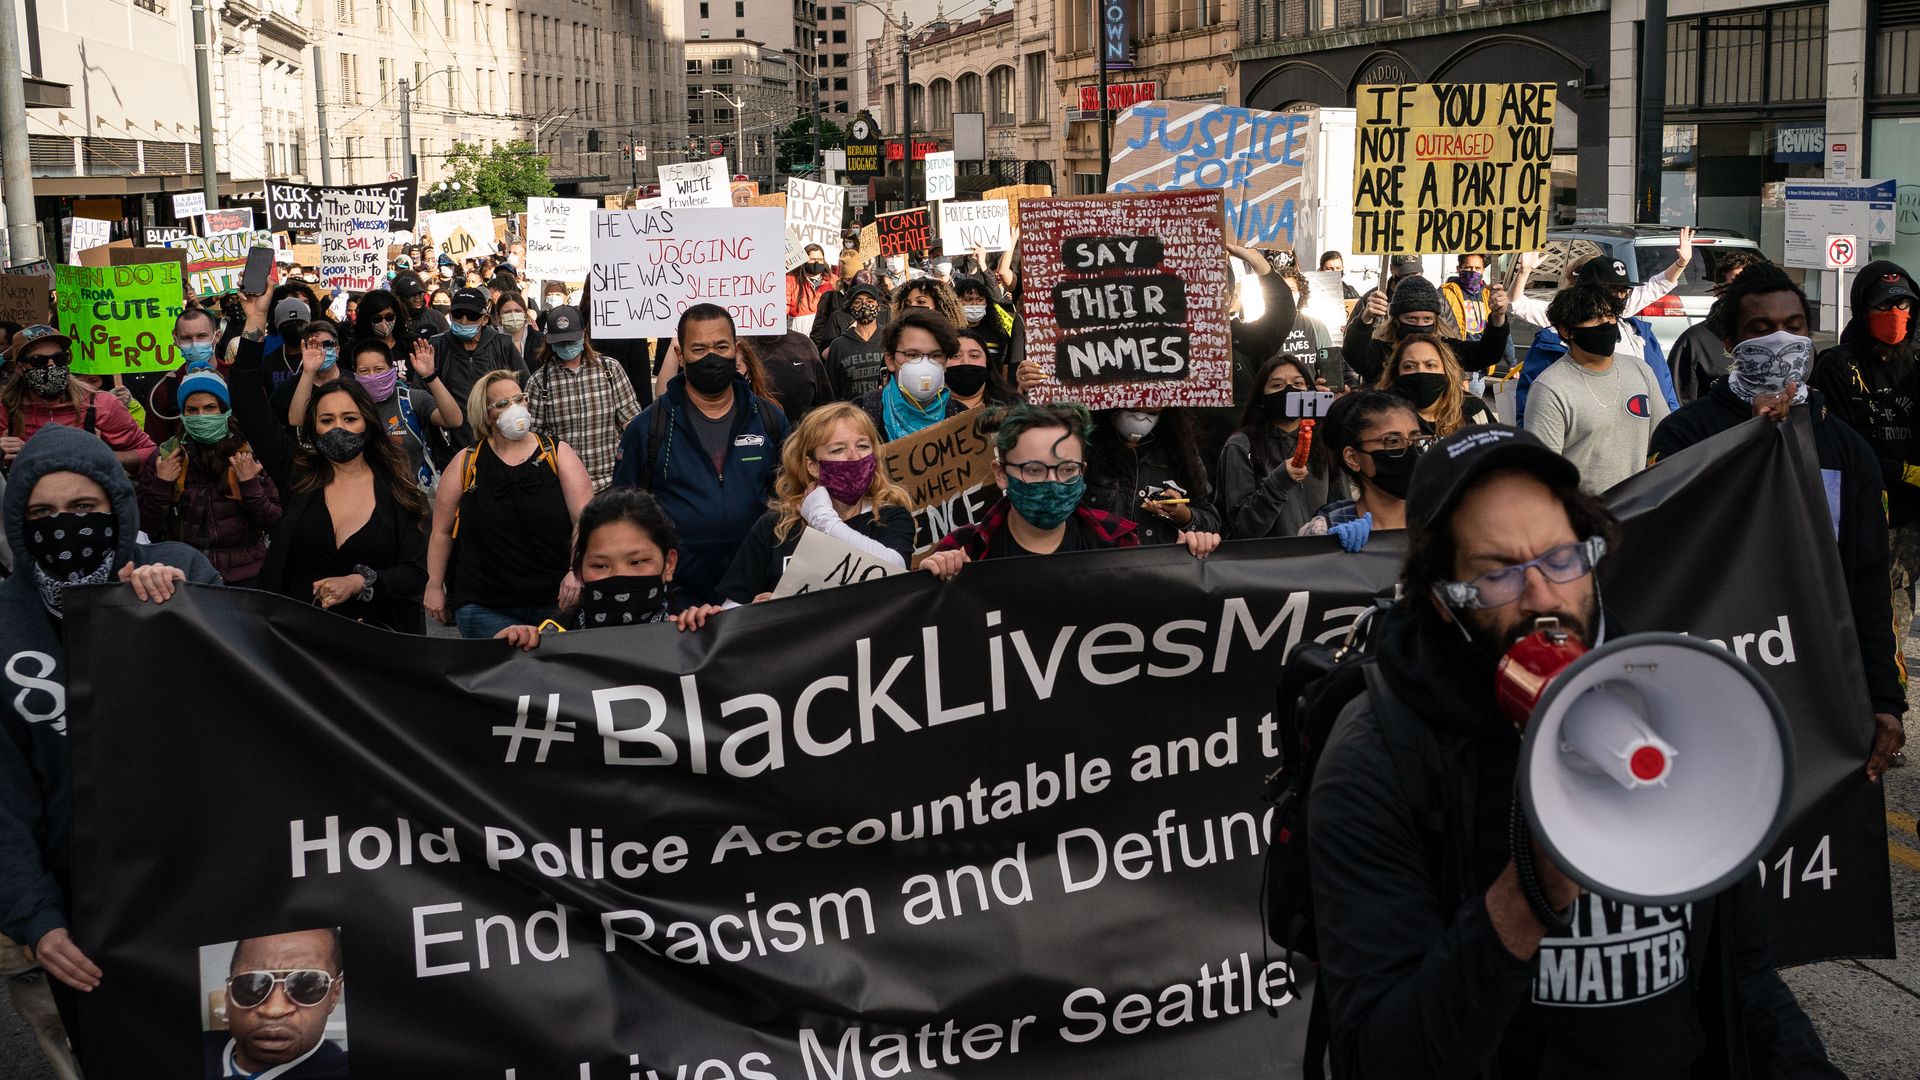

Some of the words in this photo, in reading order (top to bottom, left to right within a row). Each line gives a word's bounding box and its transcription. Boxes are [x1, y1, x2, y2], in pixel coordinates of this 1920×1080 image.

[1106, 0, 1124, 59] OWN
[1081, 87, 1101, 111] SEL
[1108, 82, 1156, 110] STORAGE
[1366, 86, 1417, 126] IF
[1432, 84, 1487, 126] YOU
[1497, 84, 1557, 125] ARE
[1127, 107, 1309, 166] JUSTICE
[1361, 127, 1411, 164] NOT
[1416, 133, 1494, 158] OUTRAGED
[1508, 126, 1554, 162] YOU
[847, 145, 877, 156] BERGMAN
[664, 168, 683, 182] USE
[848, 157, 877, 171] LUGGAGE
[926, 157, 953, 170] DEFUND
[1172, 155, 1253, 190] FOR
[271, 186, 310, 201] KICK
[390, 187, 408, 204] OF
[676, 175, 712, 195] WHITE
[790, 179, 842, 208] BLACK
[928, 175, 953, 193] SPD
[1355, 165, 1406, 208] ARE
[1418, 162, 1439, 208] A
[1453, 162, 1513, 207] PART
[1518, 162, 1551, 205] OF
[175, 195, 202, 203] LABOR
[274, 203, 303, 220] OUR
[325, 198, 351, 215] The
[354, 200, 386, 216] ONLY
[543, 199, 570, 216] White
[669, 195, 710, 208] Privilege
[288, 221, 317, 229] BLACK
[597, 213, 621, 239] HE
[627, 210, 673, 235] WAS
[791, 200, 841, 229] LIVES
[945, 206, 974, 223] POLICE
[976, 204, 1008, 220] REFORM
[1021, 210, 1081, 221] CHRISTOPHER
[75, 220, 107, 237] BLUE
[146, 229, 186, 242] BLACK
[791, 223, 841, 248] MATTER
[960, 223, 1000, 248] NOW
[1355, 209, 1405, 253] THE
[1415, 205, 1547, 253] PROBLEM.
[322, 238, 347, 252] FOR
[347, 238, 371, 250] EVIL
[373, 236, 385, 249] to
[442, 233, 475, 255] BLM
[528, 240, 553, 252] Black
[646, 236, 755, 266] JOGGING
[1024, 243, 1053, 252] KING
[1076, 240, 1139, 267] SAY
[322, 265, 346, 276] GOOD
[368, 264, 381, 276] to
[363, 252, 379, 264] FOR
[0, 277, 34, 299] RACISM
[56, 265, 104, 289] WHEN
[114, 265, 153, 288] DO
[161, 263, 178, 285] I
[593, 263, 633, 292] SHE
[637, 263, 685, 287] WAS
[685, 272, 776, 300] SLEEPING
[58, 292, 81, 313] GO
[81, 288, 114, 300] FROM
[92, 298, 161, 321] CUTE
[166, 306, 182, 318] TO
[593, 299, 621, 327] HE
[626, 293, 671, 322] WAS
[1062, 283, 1166, 319] THEIR
[67, 322, 179, 368] ANGEROU
[1283, 340, 1310, 352] LIVES
[1286, 330, 1306, 340] ACK
[841, 352, 884, 368] WELCO
[1067, 336, 1184, 378] NAMES
[909, 421, 988, 476] COMES
[913, 461, 970, 506] WHEN
[492, 584, 1375, 778] #BlackLivesMa
[290, 816, 461, 878] Hold
[484, 826, 689, 879] Police
[711, 753, 1112, 864] Accountable
[1130, 717, 1238, 781] and
[412, 902, 570, 978] End
[601, 887, 876, 966] Racism
[901, 841, 1033, 926] and
[1057, 805, 1276, 893] Defun
[1539, 929, 1686, 1003] MATTER
[800, 1014, 1036, 1080] Matter
[1059, 952, 1296, 1043] Seattle
